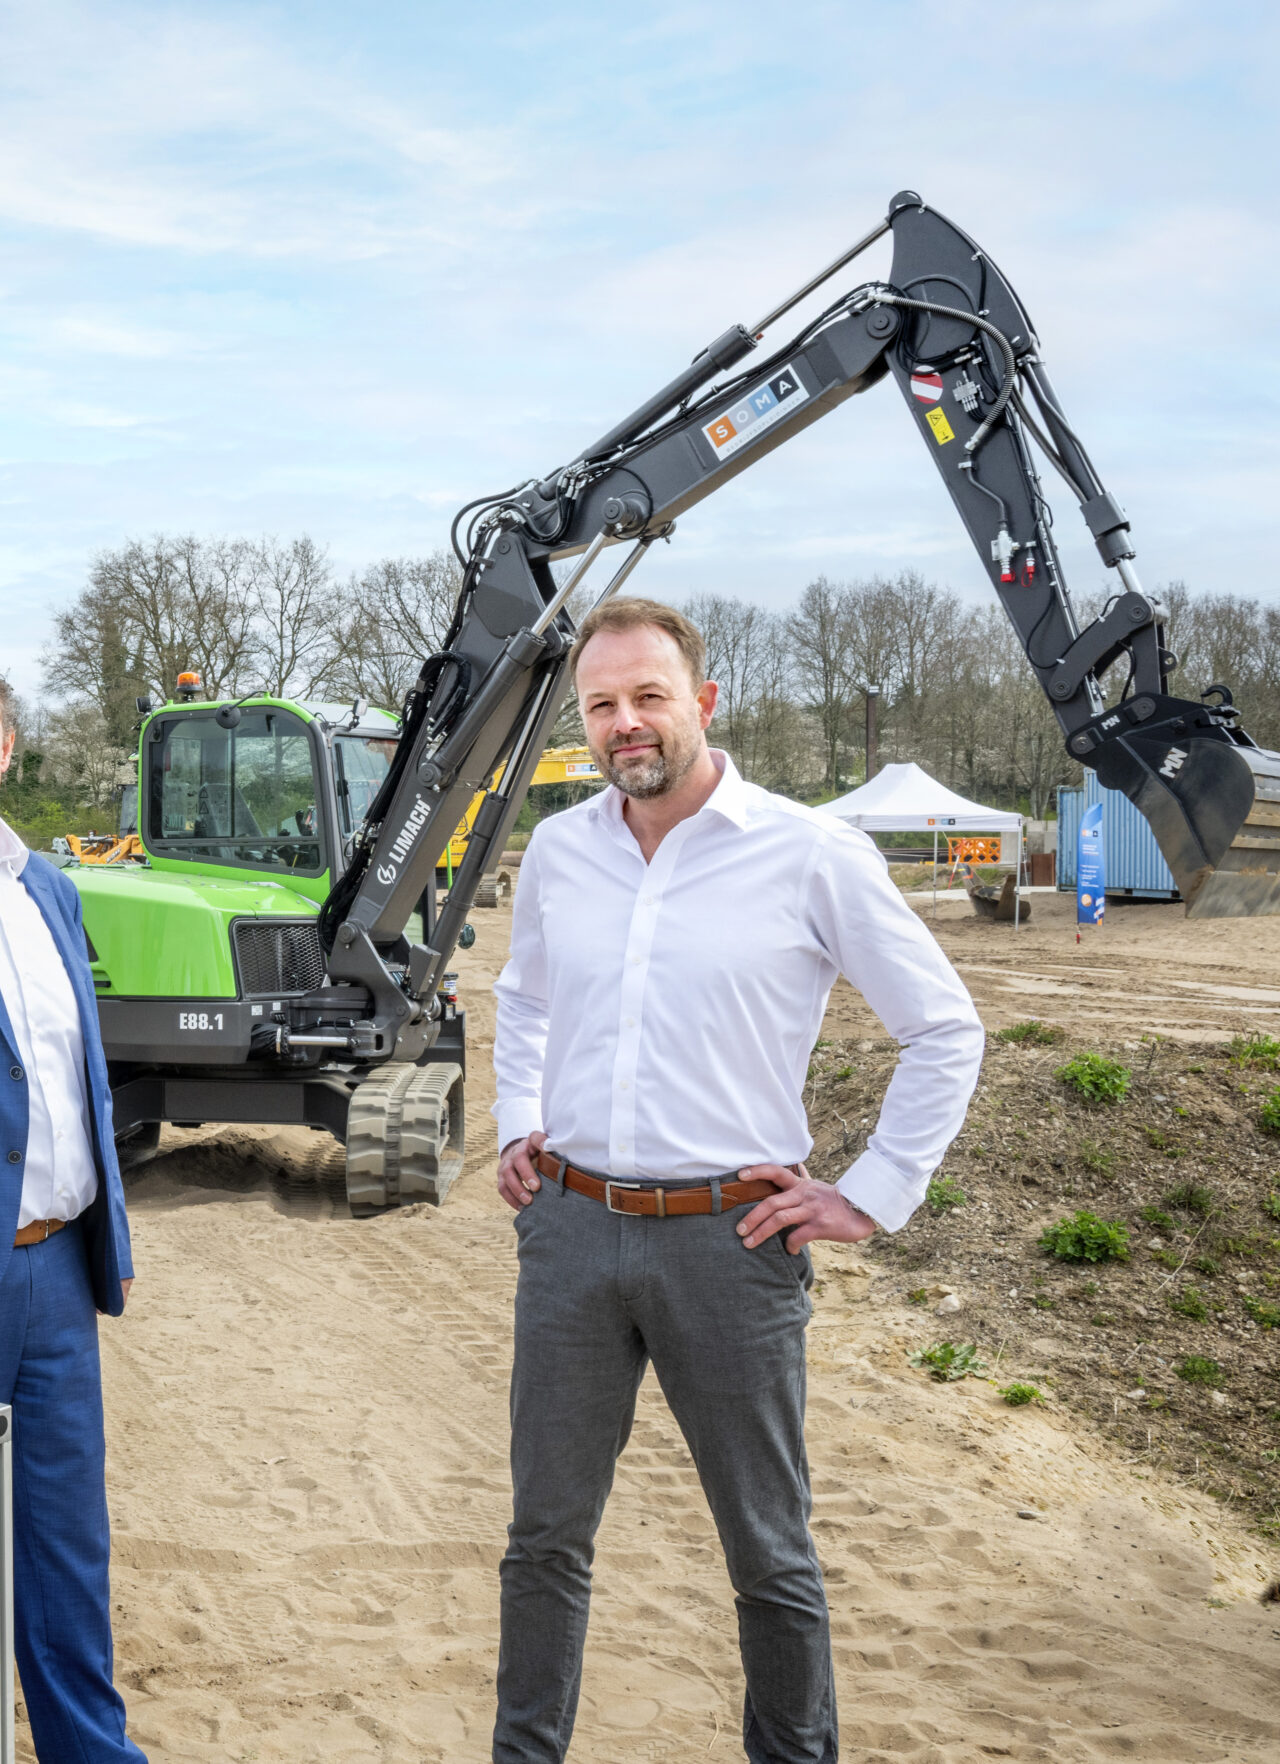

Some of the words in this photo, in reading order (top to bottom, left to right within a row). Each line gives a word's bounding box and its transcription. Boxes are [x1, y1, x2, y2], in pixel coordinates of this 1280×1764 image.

[715, 380, 792, 438] SOMA
[1101, 715, 1120, 730] MN
[1159, 747, 1189, 778] MN
[388, 799, 431, 864] LIMACH
[179, 1012, 223, 1030] E88.1
